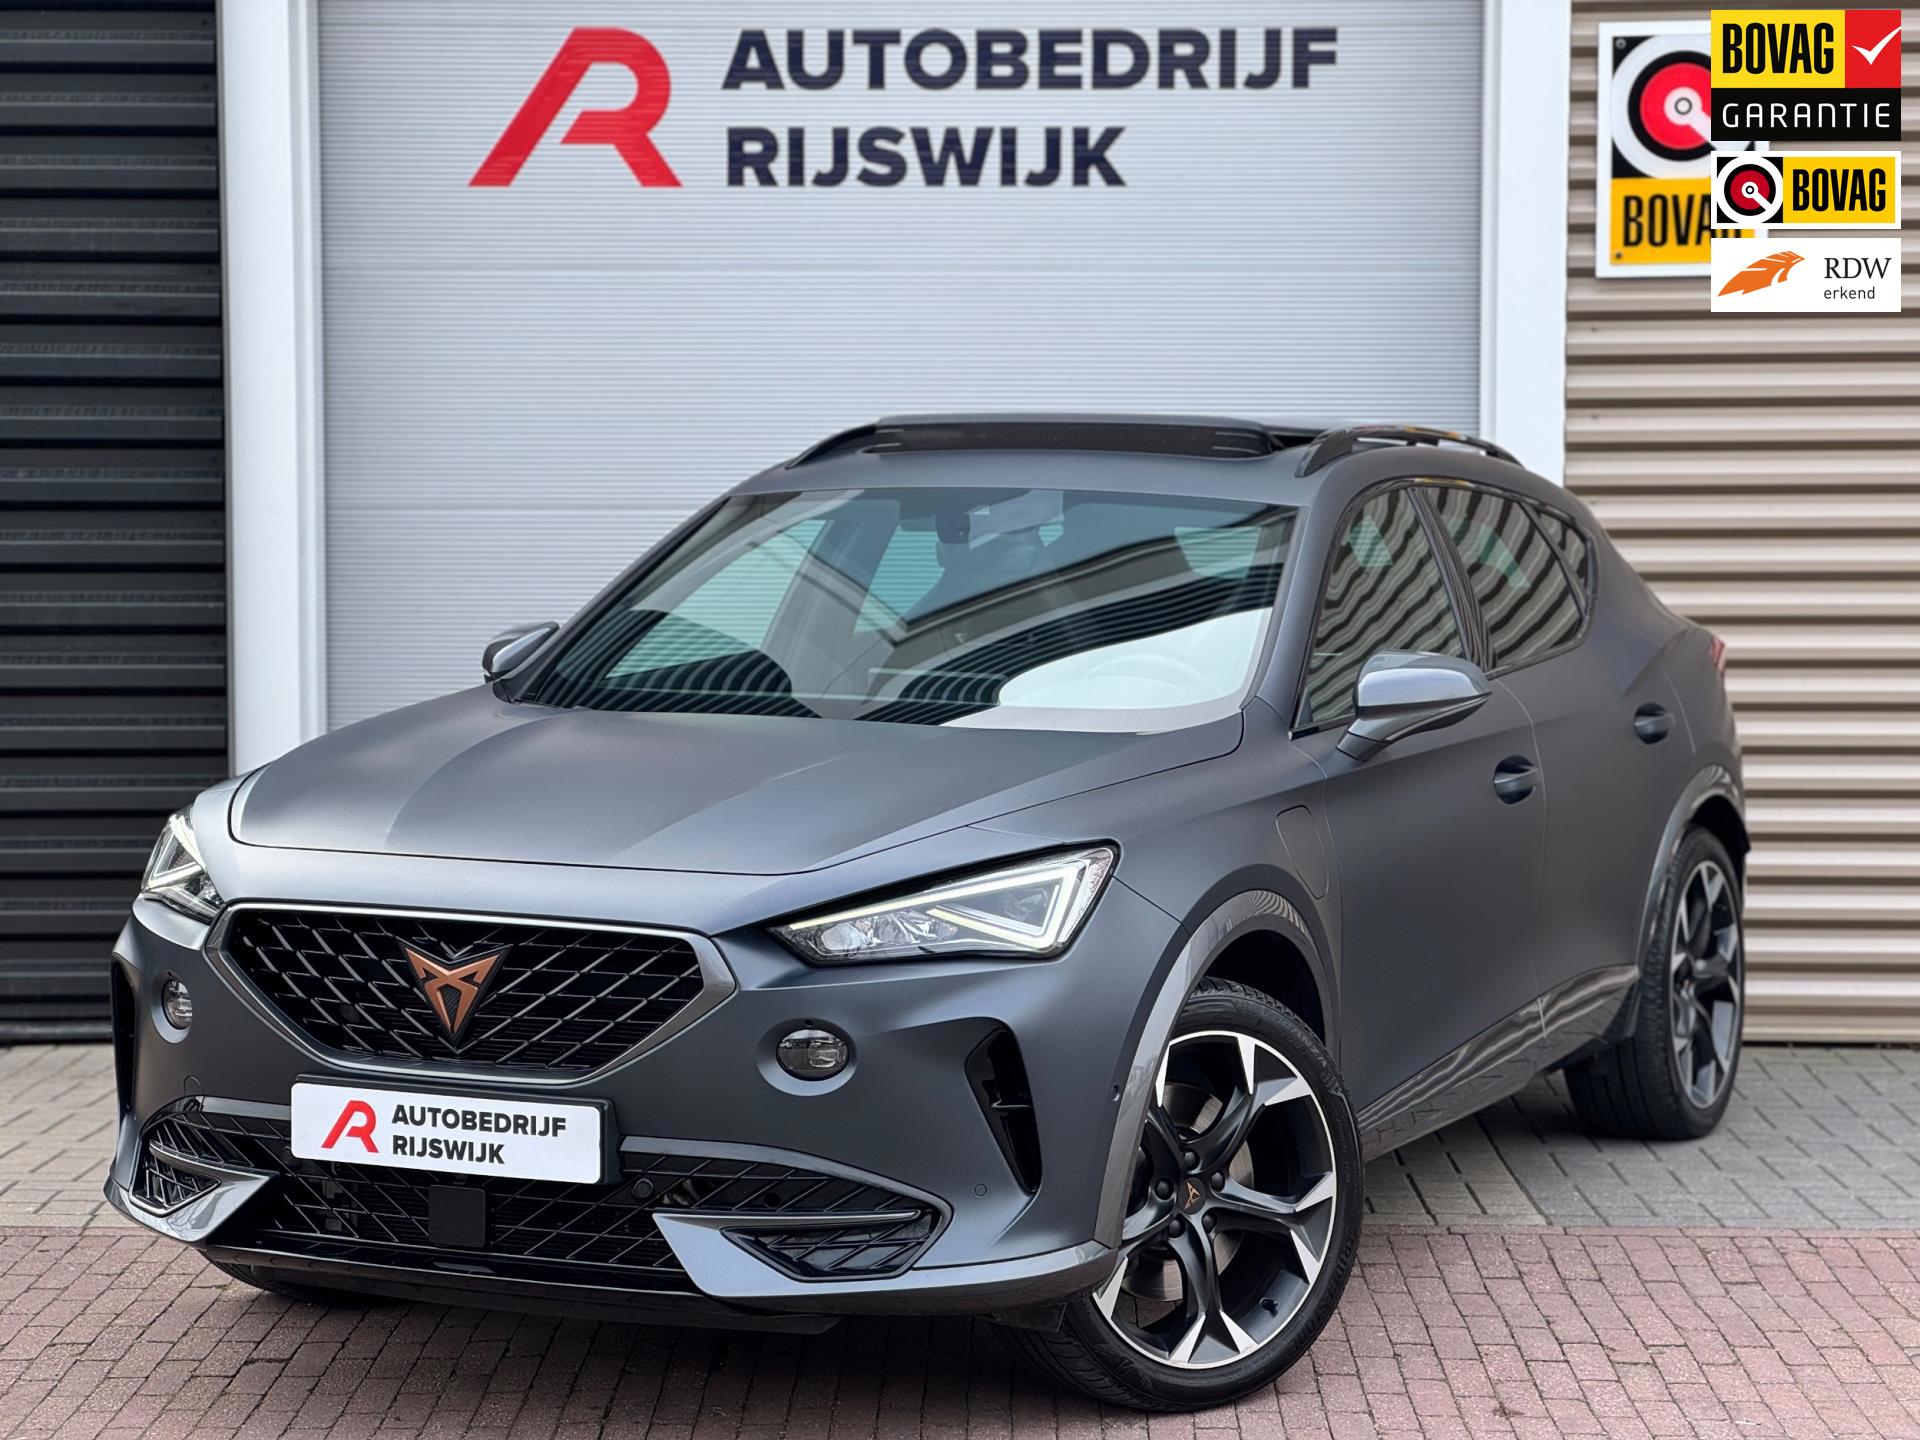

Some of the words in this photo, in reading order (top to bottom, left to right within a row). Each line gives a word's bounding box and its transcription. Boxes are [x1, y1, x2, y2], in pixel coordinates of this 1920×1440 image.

[722, 27, 1338, 90] AUTOBEDRIJF
[727, 126, 1126, 187] RIJSWIJK
[1623, 193, 1742, 247] BOVA
[391, 1104, 567, 1137] AUTOBEDRIJF
[392, 1134, 505, 1164] RIJSWIJK
